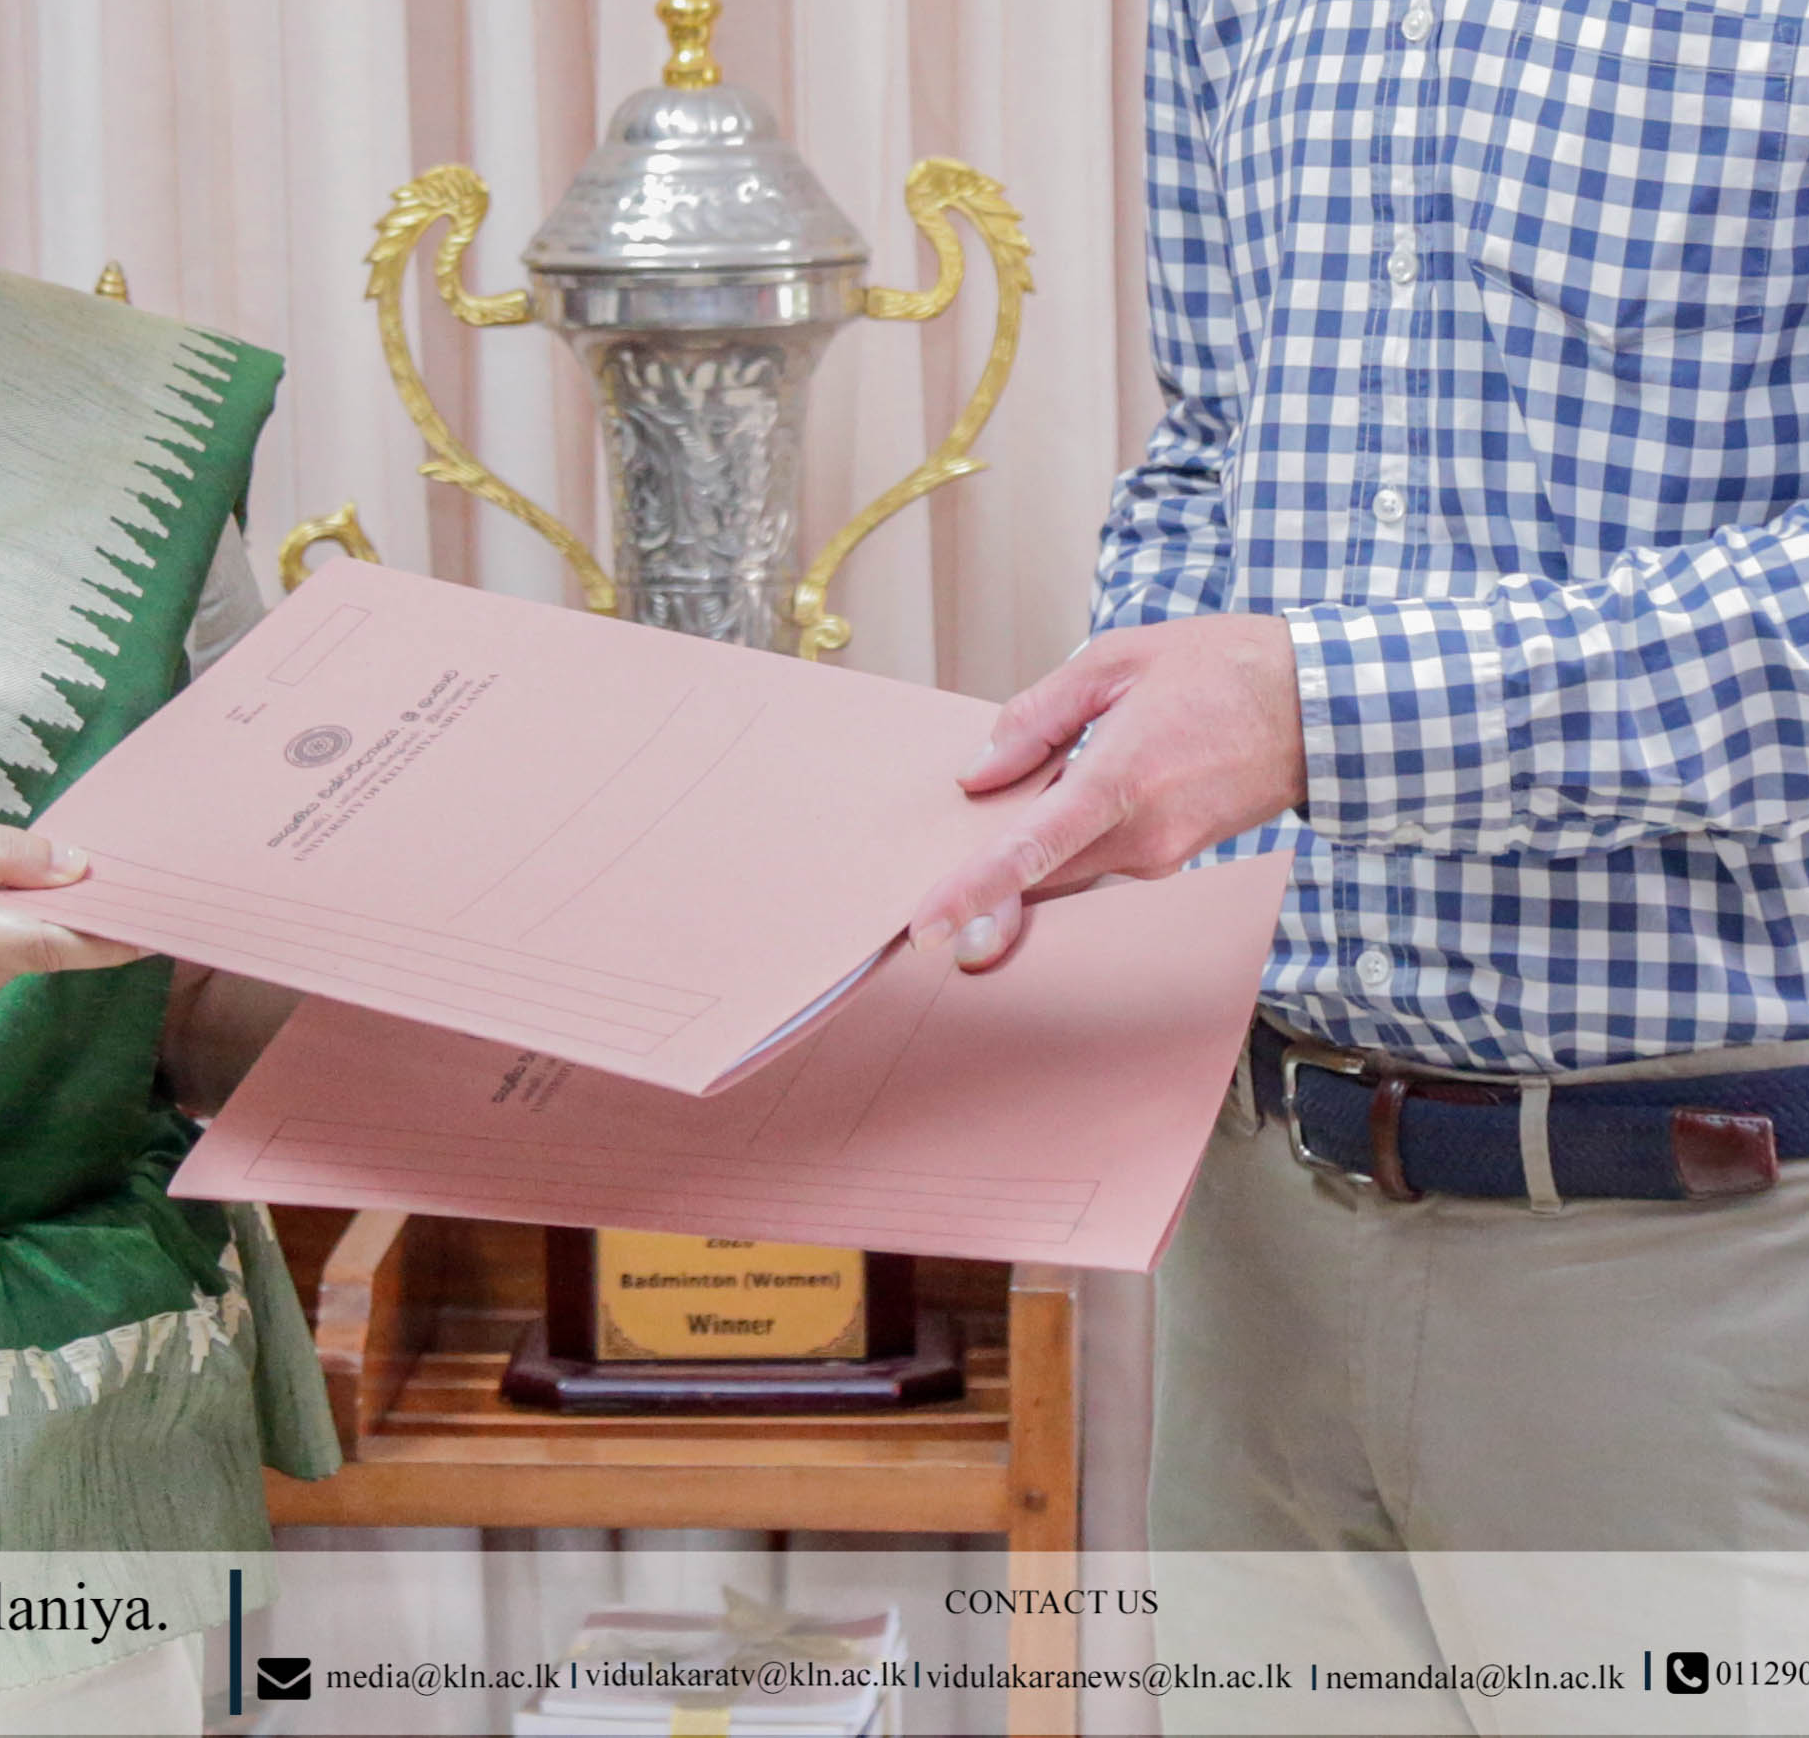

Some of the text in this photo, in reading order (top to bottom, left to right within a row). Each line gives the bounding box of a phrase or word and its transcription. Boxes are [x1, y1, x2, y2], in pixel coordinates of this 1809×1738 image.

[293, 801, 365, 862] UNIVERSITY
[620, 1271, 841, 1291] Badminton (Women)
[686, 1314, 776, 1336] Winner
